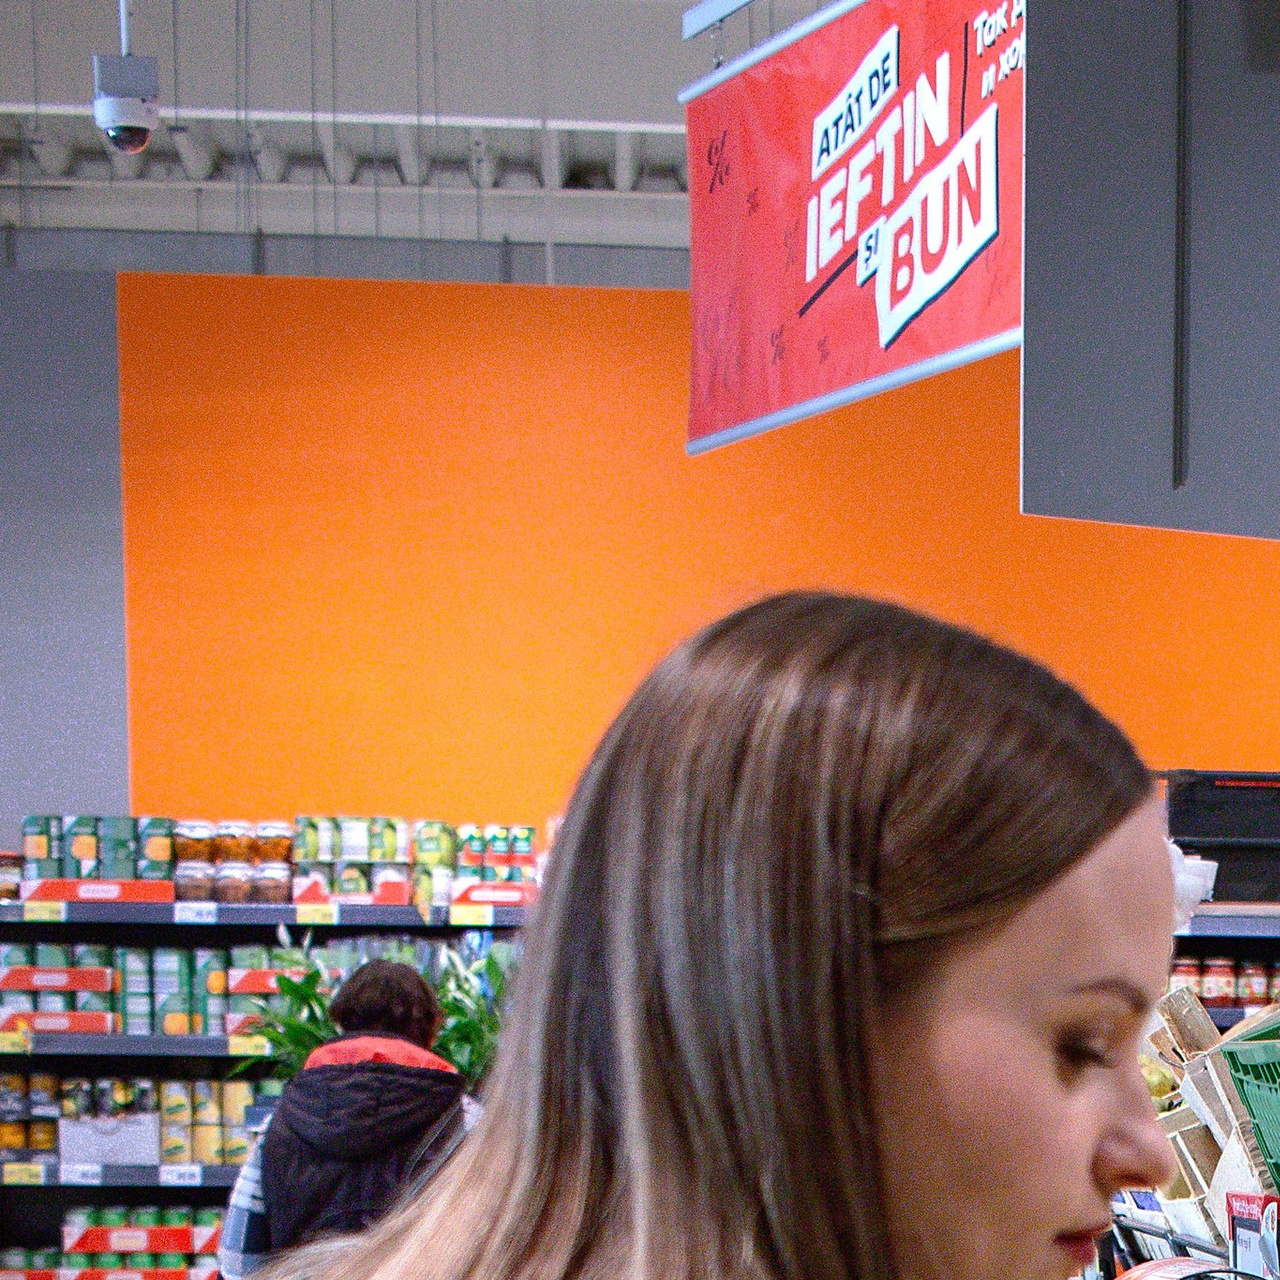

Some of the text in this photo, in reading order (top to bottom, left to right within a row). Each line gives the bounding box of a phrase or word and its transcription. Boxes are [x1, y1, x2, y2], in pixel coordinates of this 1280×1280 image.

[805, 51, 950, 283] IEFTIN
[816, 51, 892, 168] ATÂT DE
[889, 133, 983, 313] BUN
